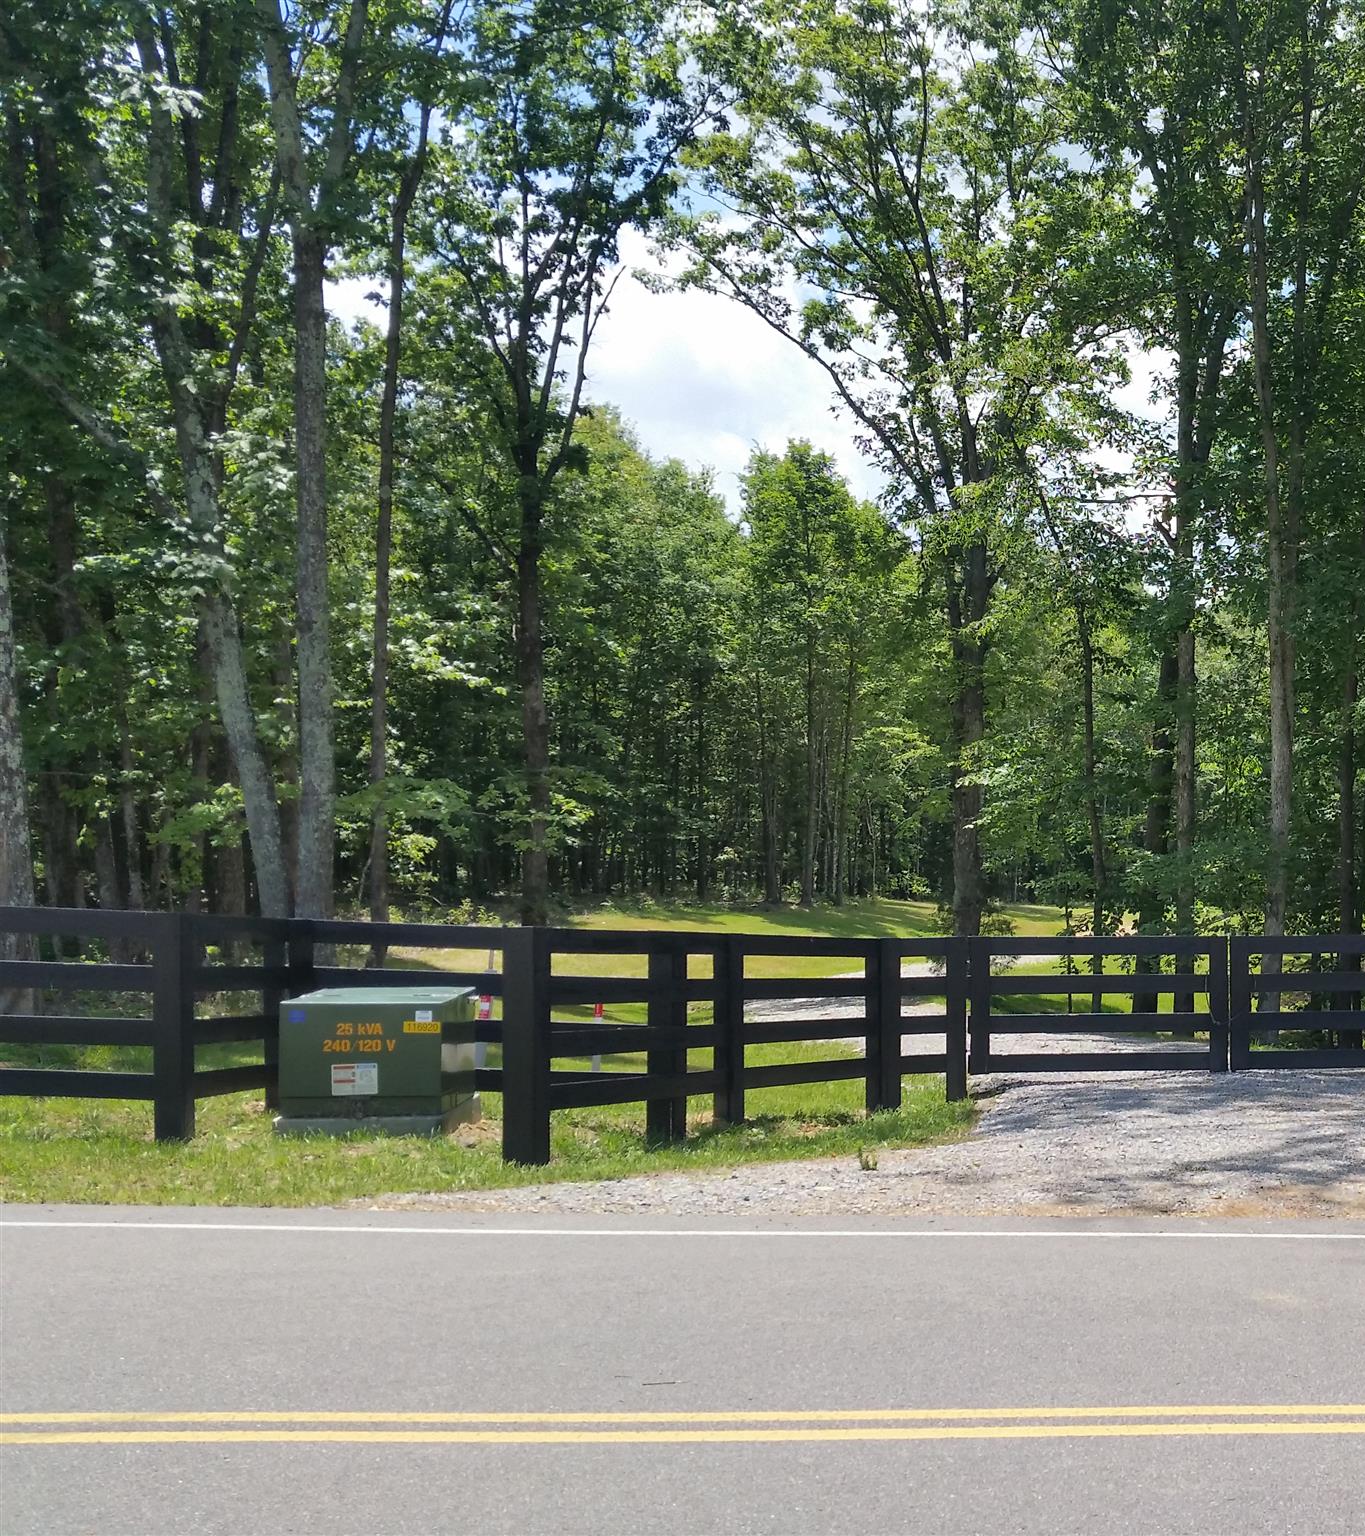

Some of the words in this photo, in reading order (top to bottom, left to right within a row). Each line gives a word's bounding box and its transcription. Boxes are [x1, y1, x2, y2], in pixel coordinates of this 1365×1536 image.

[336, 1023, 353, 1035] 25
[406, 1022, 439, 1032] 116920
[323, 1040, 382, 1053] 240/120
[386, 1040, 396, 1052] V
